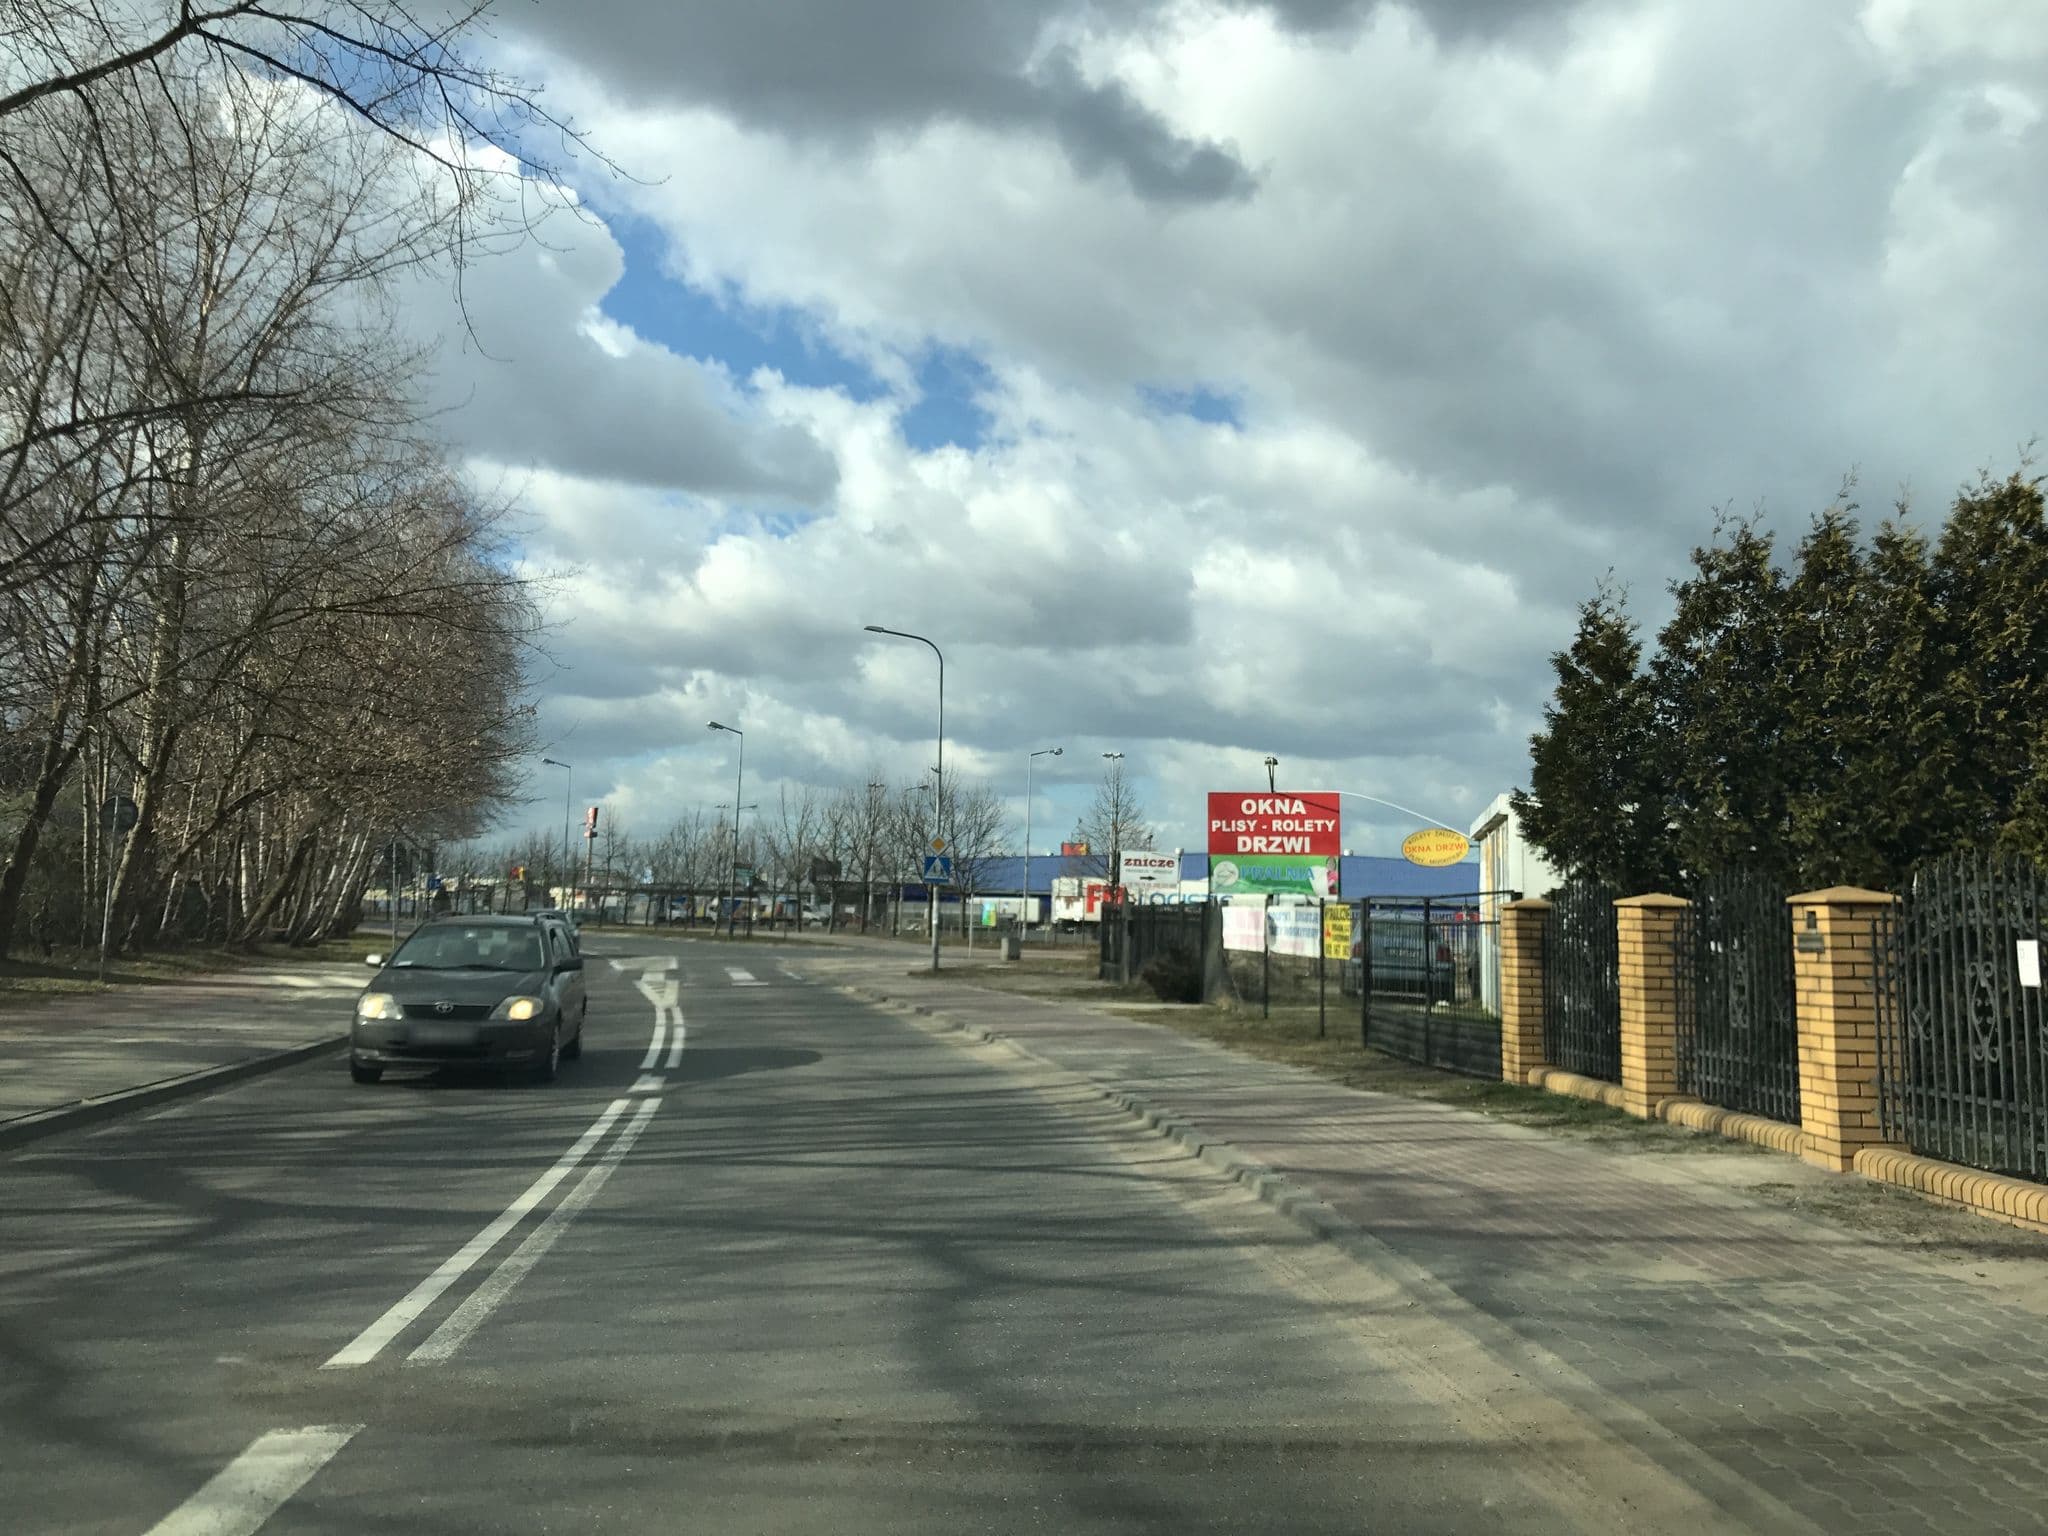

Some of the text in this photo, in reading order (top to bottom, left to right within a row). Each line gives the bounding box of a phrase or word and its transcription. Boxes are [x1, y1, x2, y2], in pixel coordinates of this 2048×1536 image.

[1240, 798, 1306, 815] OKNA
[1211, 819, 1257, 832] PLISY
[1271, 819, 1336, 832] ROLETY
[1237, 836, 1311, 853] DRZWI
[1404, 843, 1467, 854] OKNA DRZWI
[1124, 856, 1175, 868] znicze
[1241, 864, 1315, 880] PRALNIA
